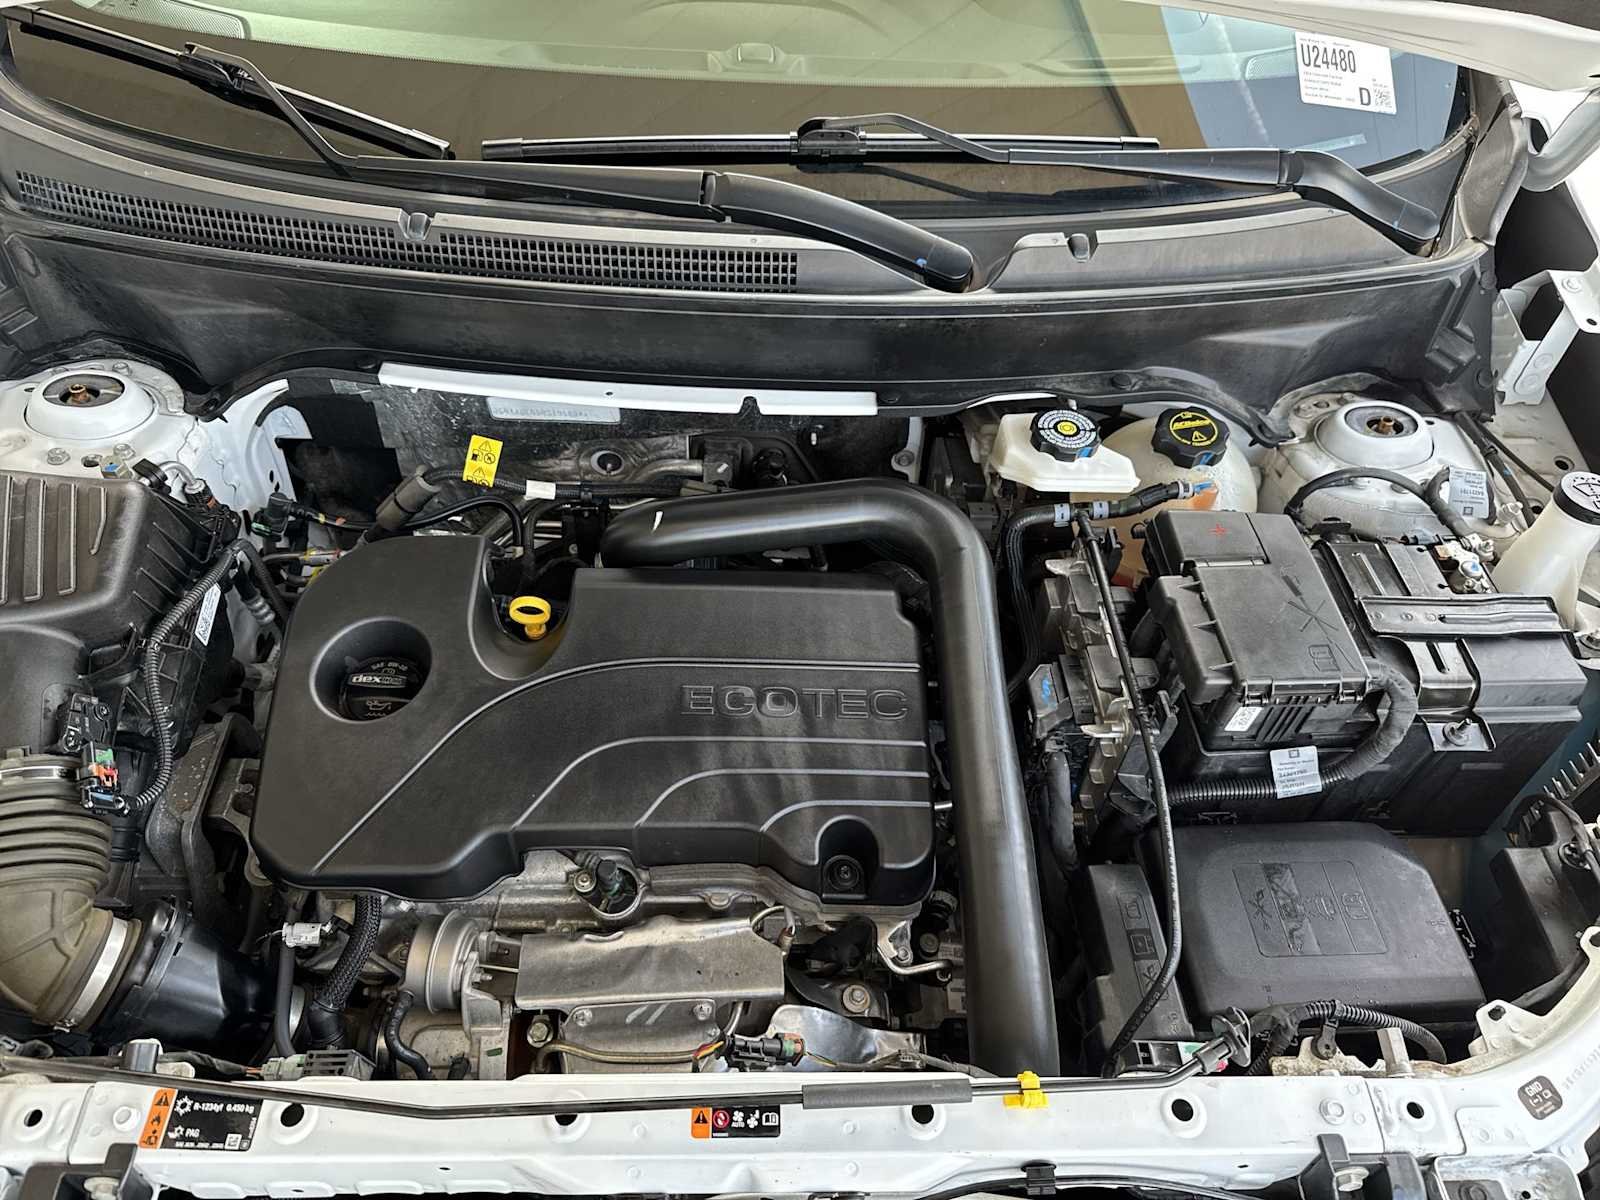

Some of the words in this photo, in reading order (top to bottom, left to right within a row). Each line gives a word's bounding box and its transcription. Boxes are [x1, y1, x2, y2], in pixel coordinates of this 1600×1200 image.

[1301, 43, 1356, 73] U24480
[1359, 86, 1371, 106] D
[681, 685, 908, 720] ECOTEC
[1524, 1081, 1543, 1097] GND
[185, 1128, 200, 1138] PAG
